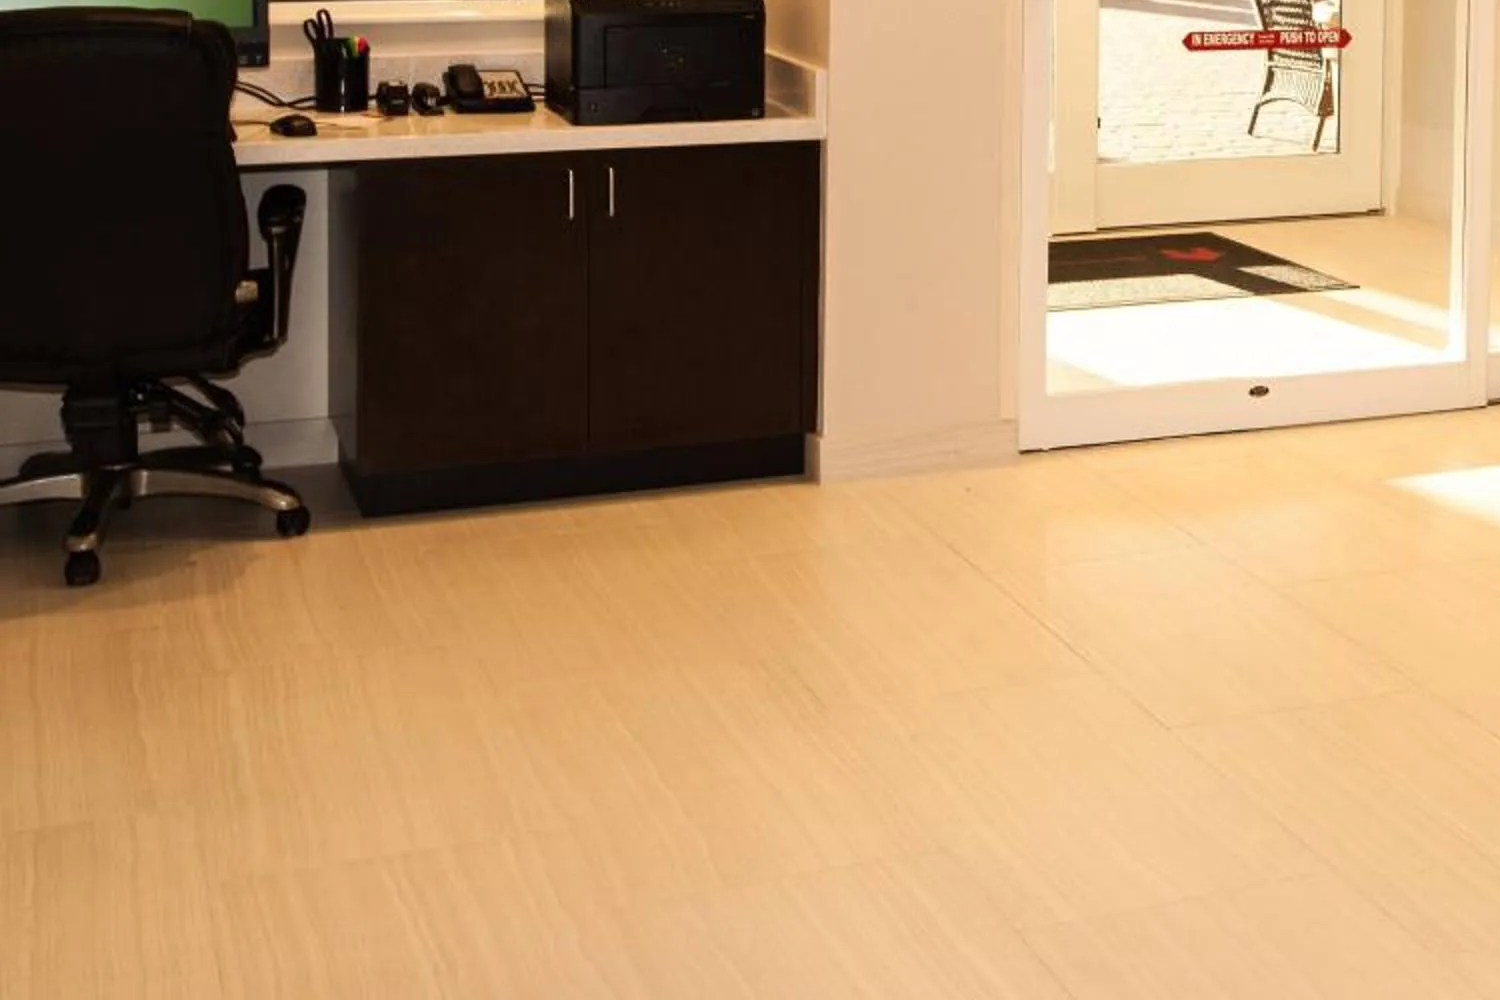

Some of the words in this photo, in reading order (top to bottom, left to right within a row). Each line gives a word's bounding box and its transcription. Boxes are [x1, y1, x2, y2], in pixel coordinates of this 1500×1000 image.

[1191, 35, 1204, 46] IN
[1204, 33, 1255, 46] EMERGENCY
[1280, 31, 1302, 44] PUSH
[1305, 31, 1317, 44] TO
[1317, 30, 1341, 43] OPEN
